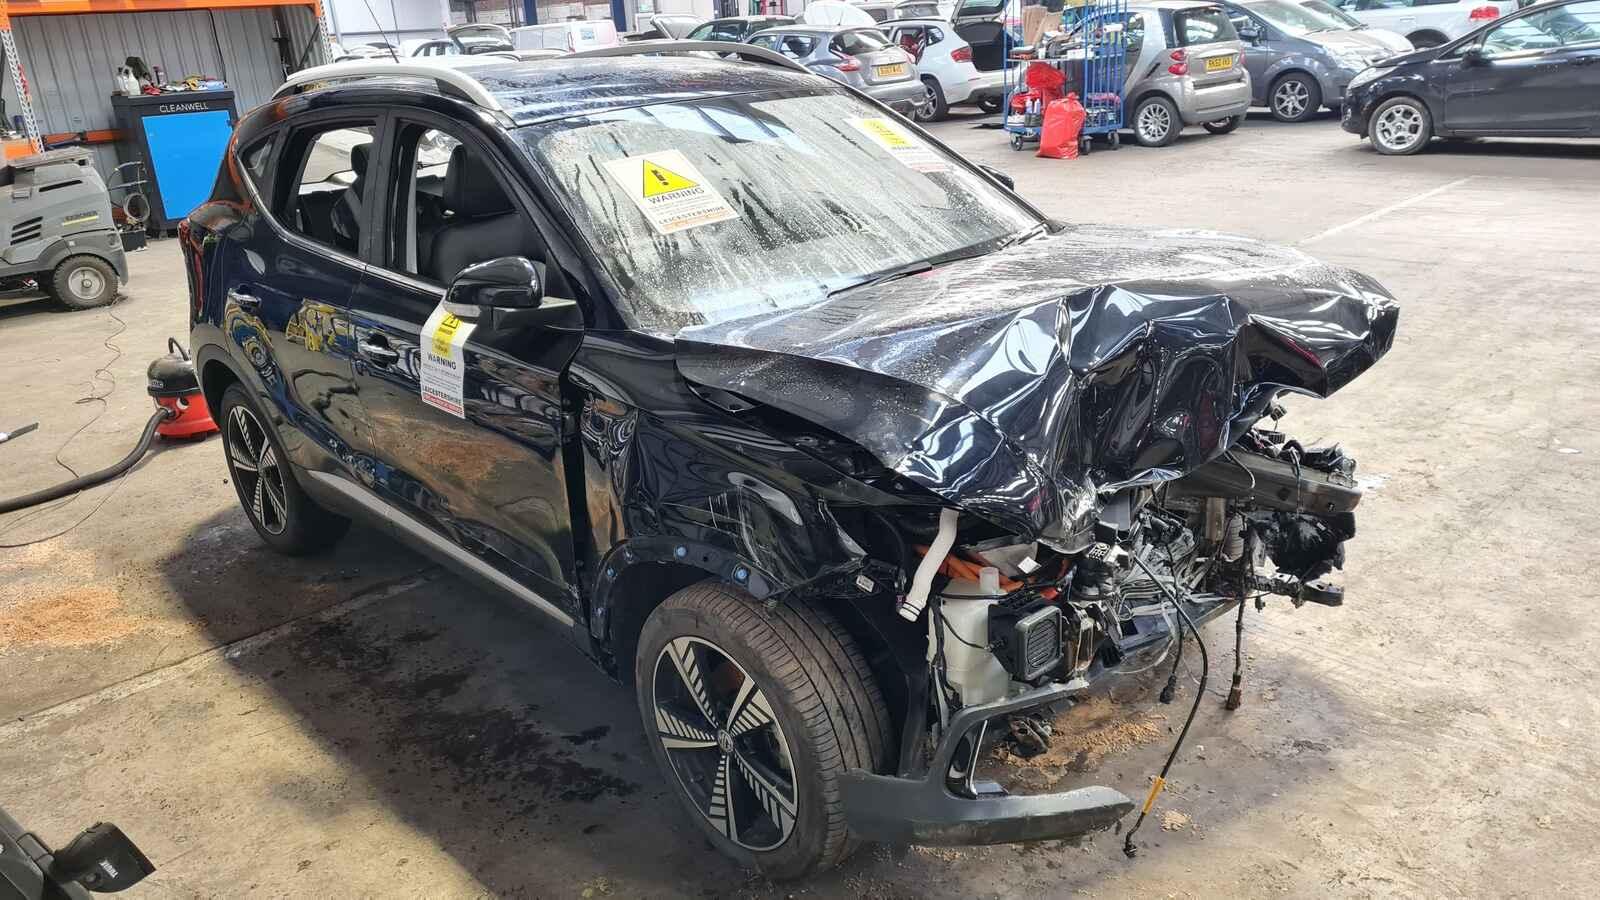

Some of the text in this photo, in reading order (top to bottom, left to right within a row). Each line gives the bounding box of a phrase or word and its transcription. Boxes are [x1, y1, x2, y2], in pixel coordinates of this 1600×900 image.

[159, 101, 209, 113] CLEANWELL
[648, 187, 705, 204] WARNING
[427, 351, 458, 370] WARNING
